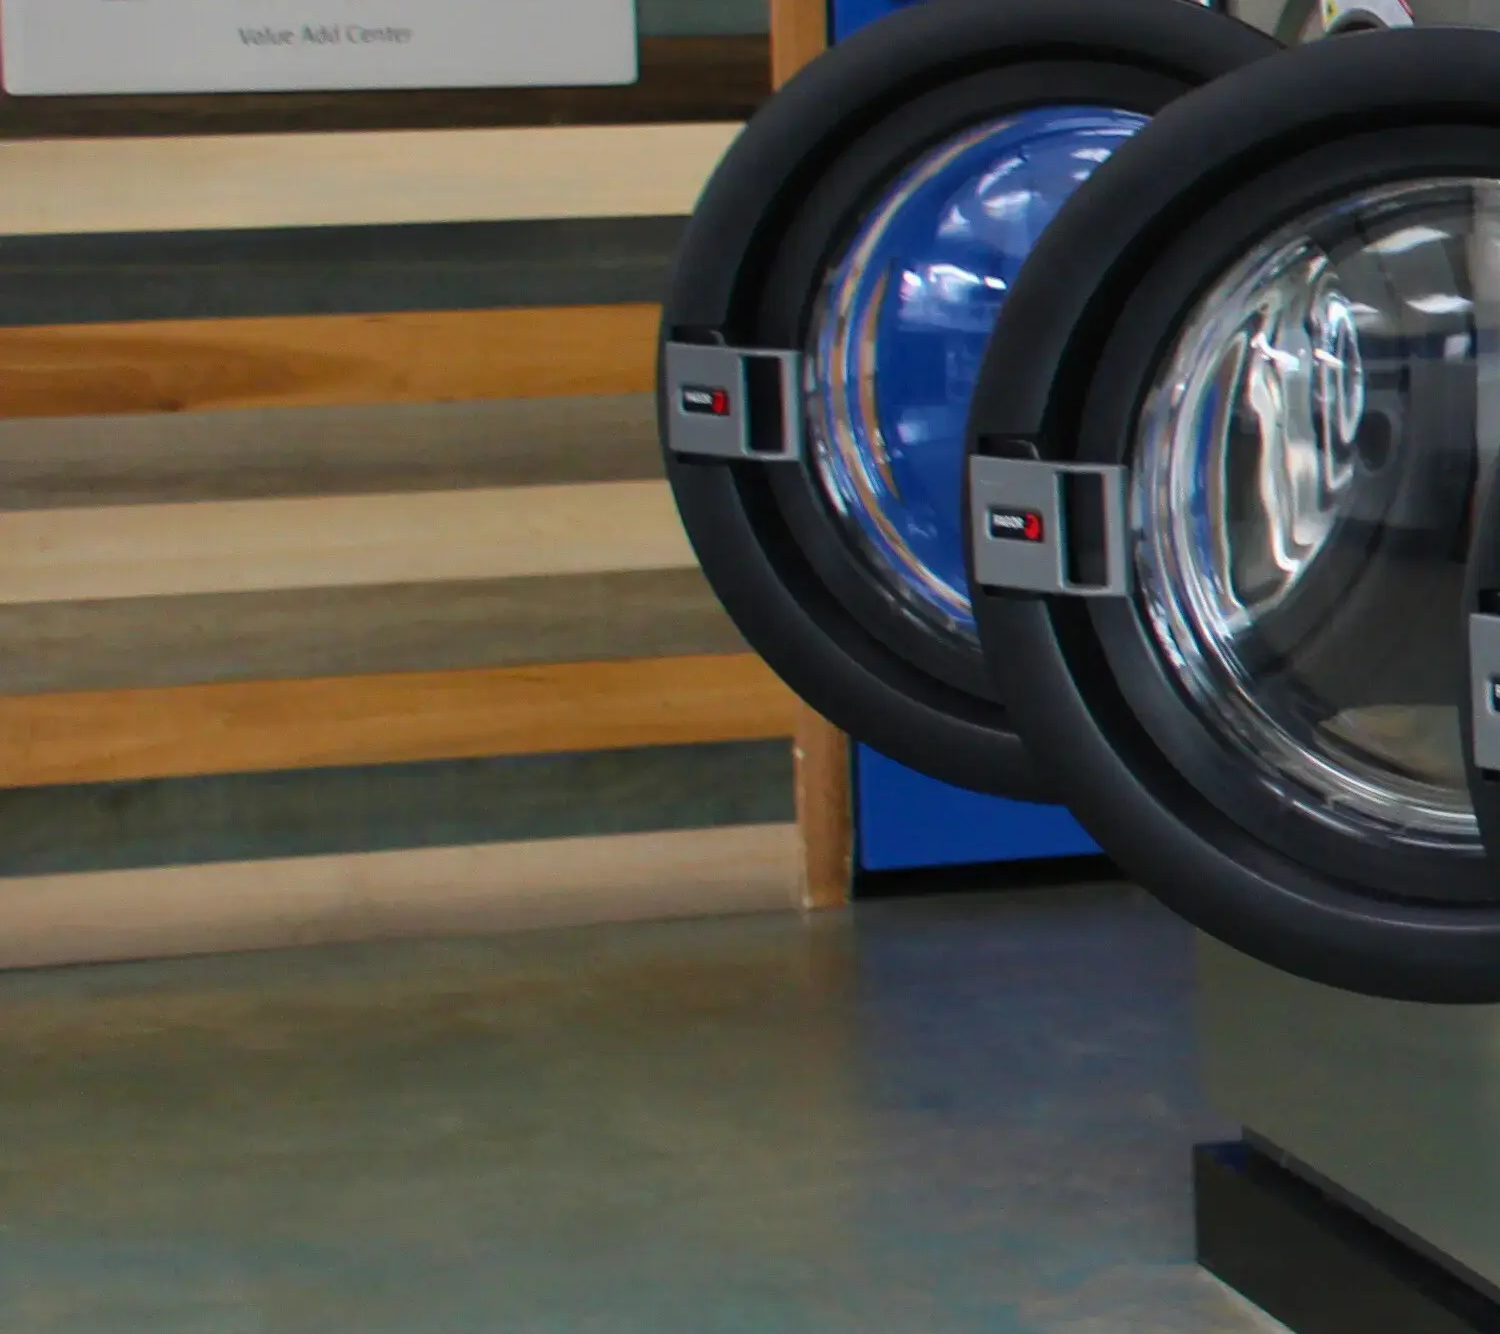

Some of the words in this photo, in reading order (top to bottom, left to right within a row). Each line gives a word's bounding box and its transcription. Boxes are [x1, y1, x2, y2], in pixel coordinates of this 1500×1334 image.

[237, 26, 296, 46] Value
[301, 23, 342, 45] Add
[345, 23, 415, 45] Center
